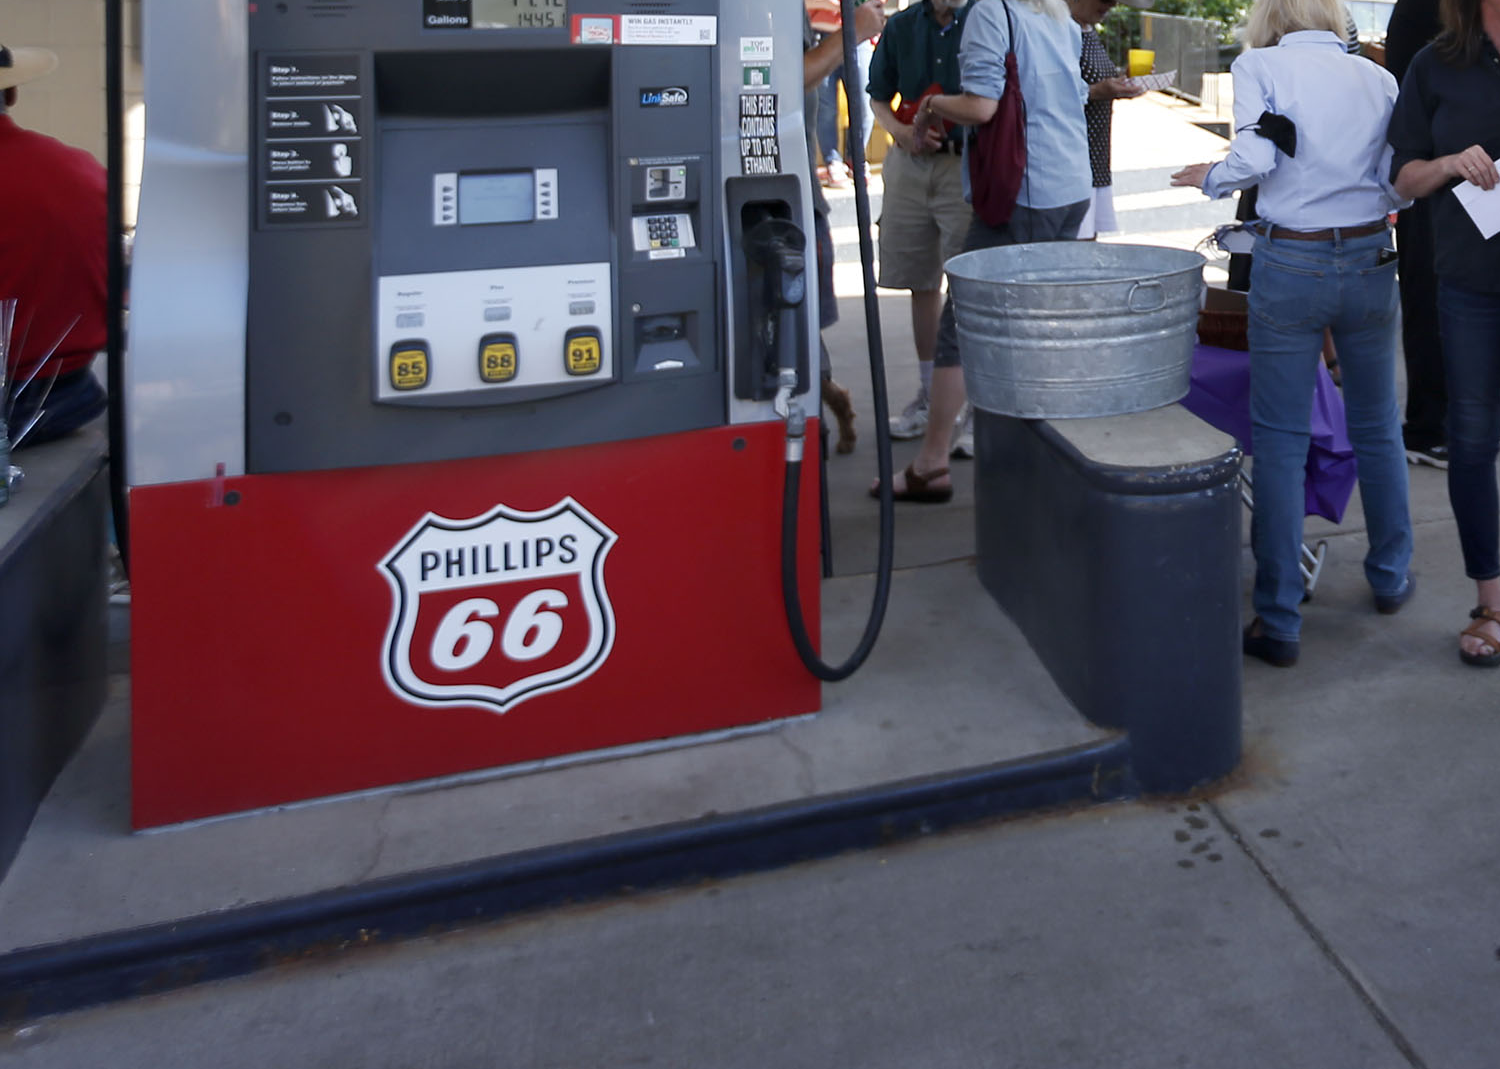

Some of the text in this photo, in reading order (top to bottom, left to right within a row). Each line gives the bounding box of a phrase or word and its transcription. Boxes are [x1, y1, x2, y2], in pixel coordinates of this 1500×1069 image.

[428, 15, 469, 24] Gallons
[658, 18, 693, 26] INSTANTLY
[271, 65, 290, 75] Step
[741, 95, 776, 116] THIS FUEL
[271, 112, 290, 121] Step
[741, 116, 776, 137] CONTAINS
[271, 150, 290, 159] Step
[741, 138, 778, 156] UP TO 10%
[744, 156, 778, 174] ETHANOL
[271, 193, 290, 202] Step
[486, 353, 513, 369] 88
[571, 348, 598, 362] 91
[396, 361, 424, 378] 85
[420, 534, 578, 582] PHILLIPS
[430, 588, 569, 673] 66
